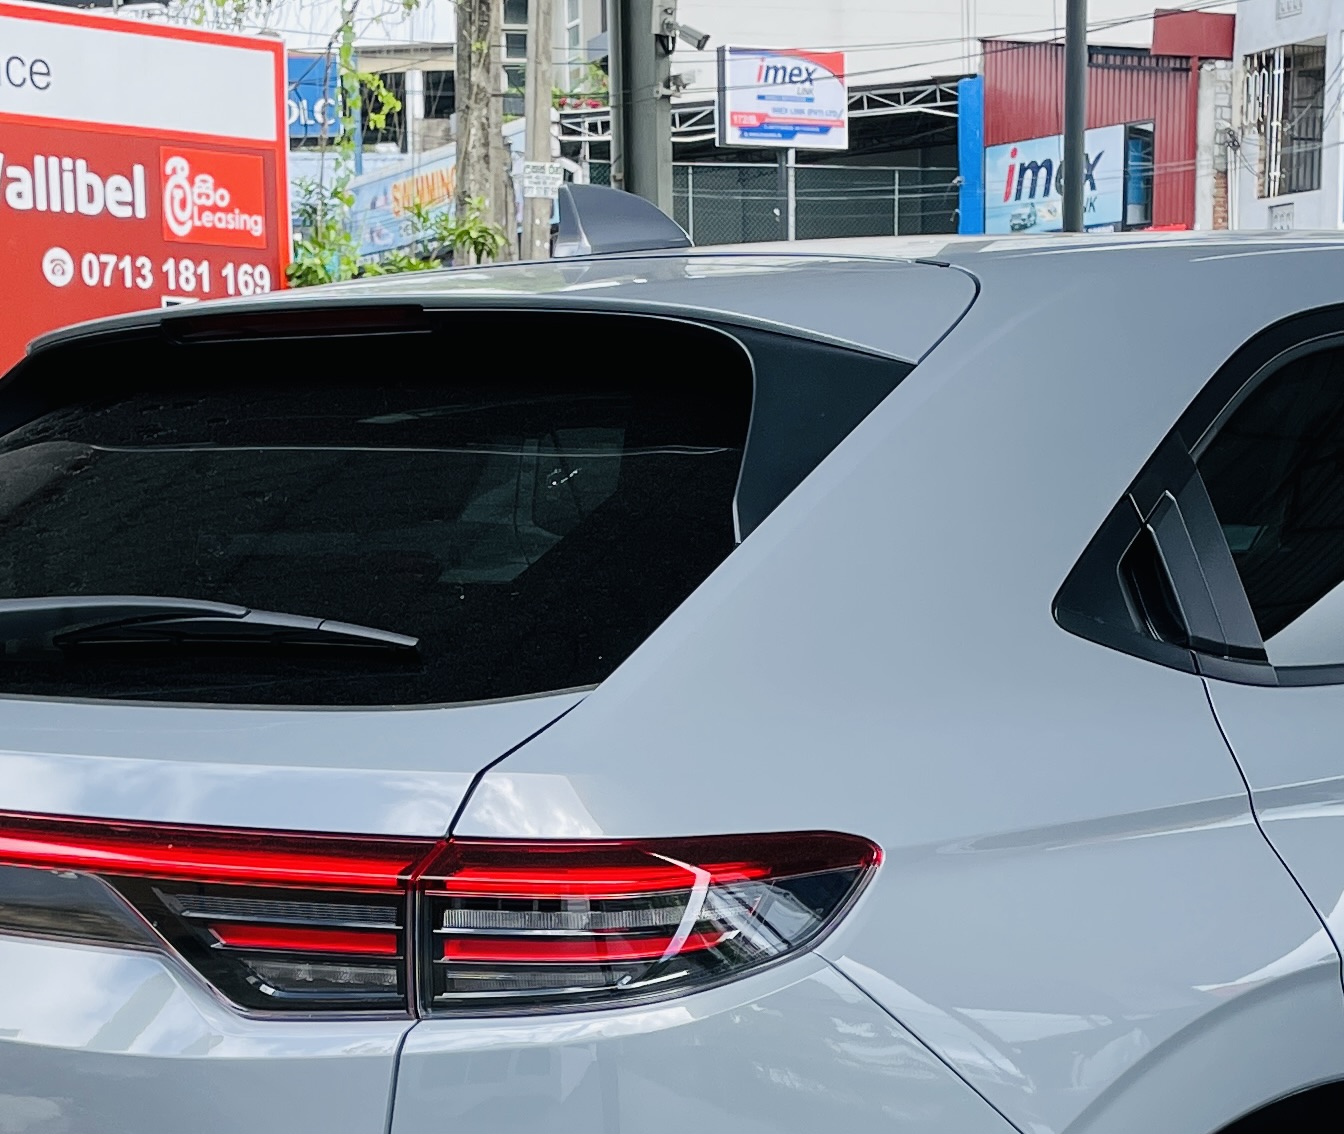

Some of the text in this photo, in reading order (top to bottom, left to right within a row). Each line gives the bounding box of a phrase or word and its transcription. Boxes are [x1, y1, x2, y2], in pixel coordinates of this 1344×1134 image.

[757, 57, 817, 86] imex
[193, 205, 262, 236] Leasing
[81, 252, 271, 296] 0713 181 169
